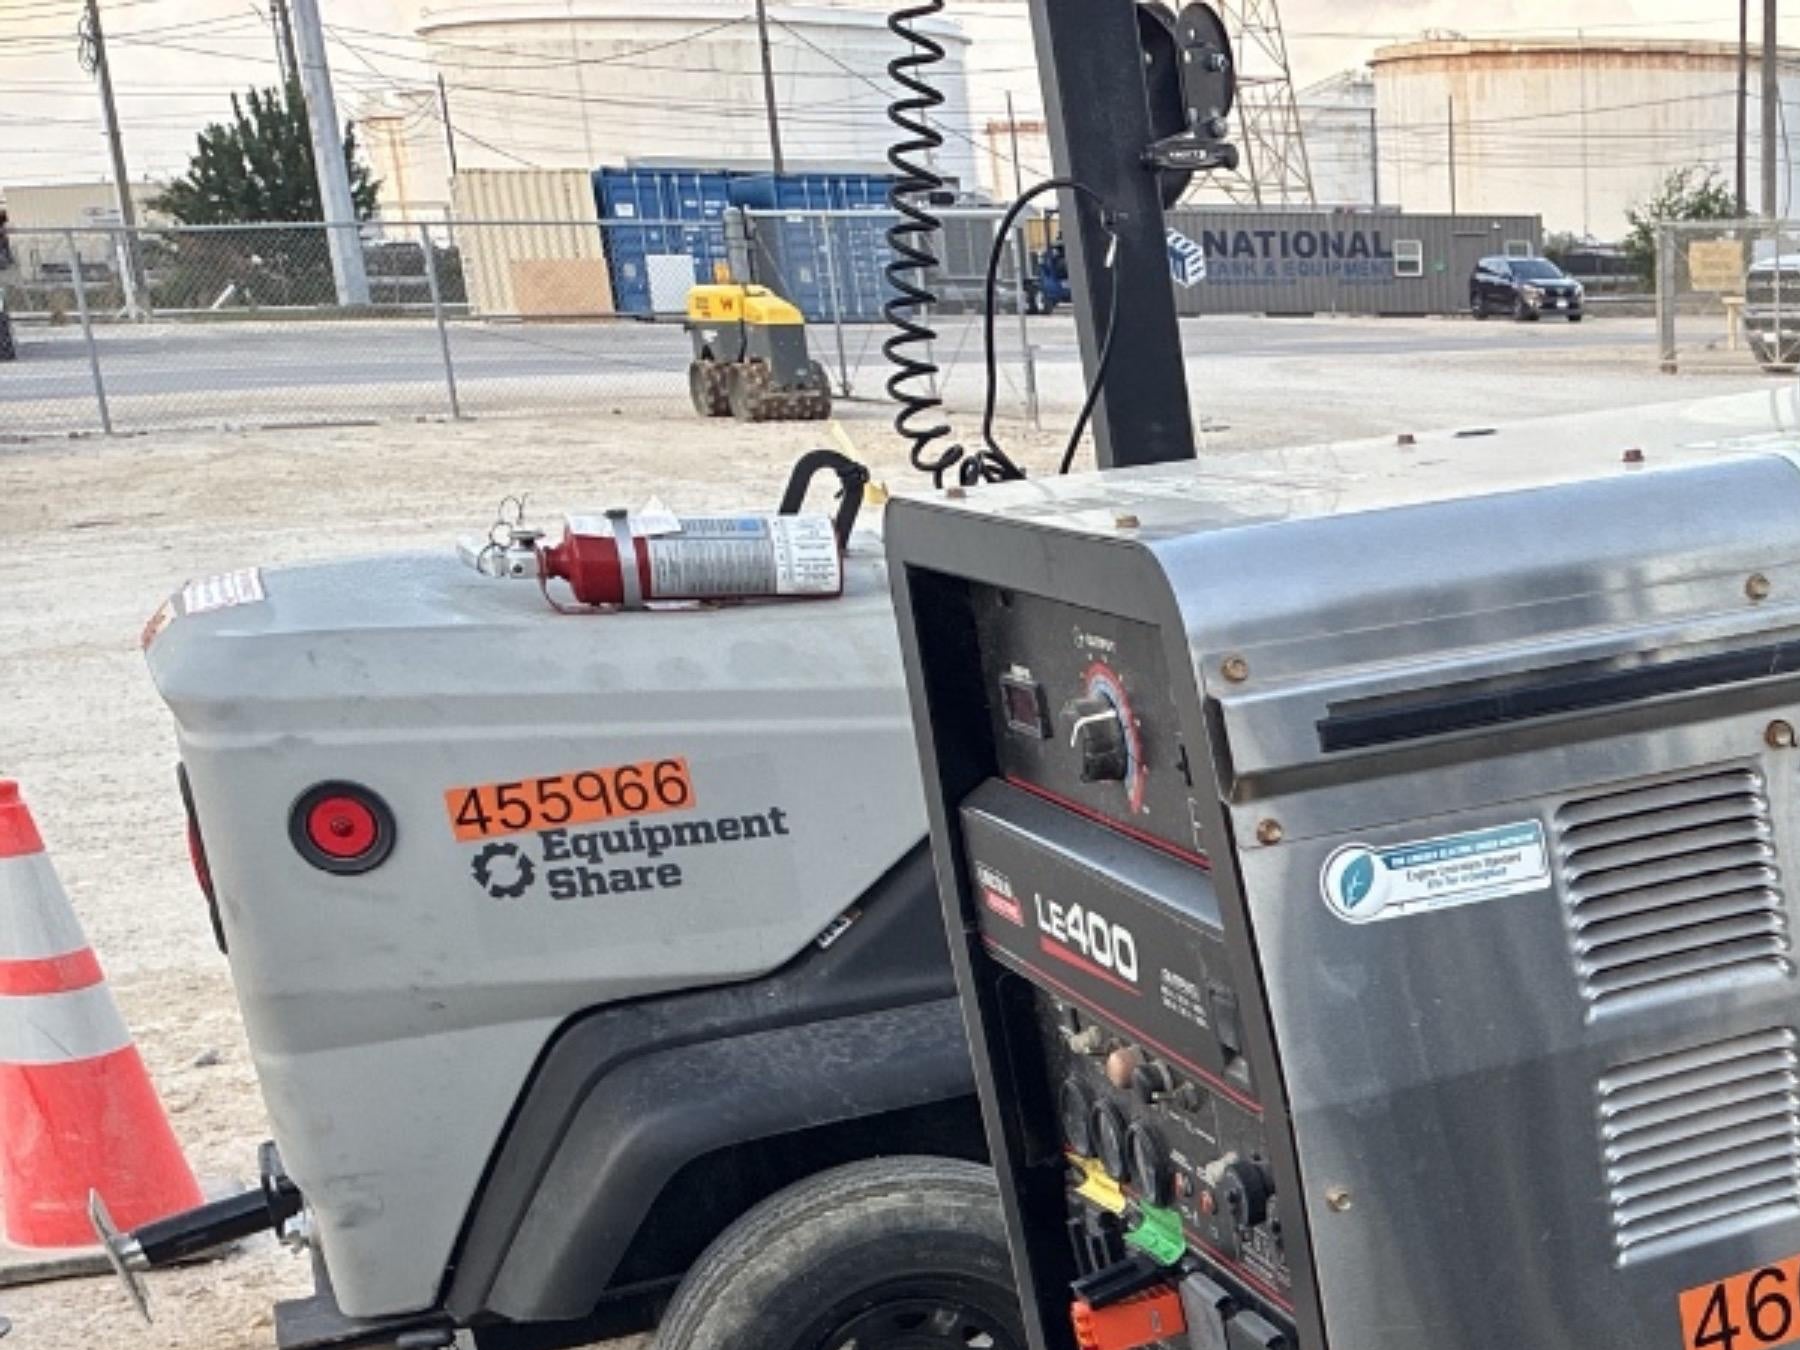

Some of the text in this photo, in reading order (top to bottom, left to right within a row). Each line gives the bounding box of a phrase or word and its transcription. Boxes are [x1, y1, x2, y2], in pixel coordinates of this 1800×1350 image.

[1202, 229, 1393, 258] NATIONAL
[1207, 260, 1257, 277] TANK
[1287, 260, 1394, 278] EQUIPMENT
[454, 758, 690, 836] 455966
[536, 806, 791, 864] Equipment
[545, 862, 684, 901] Share
[1034, 892, 1139, 983] LE400
